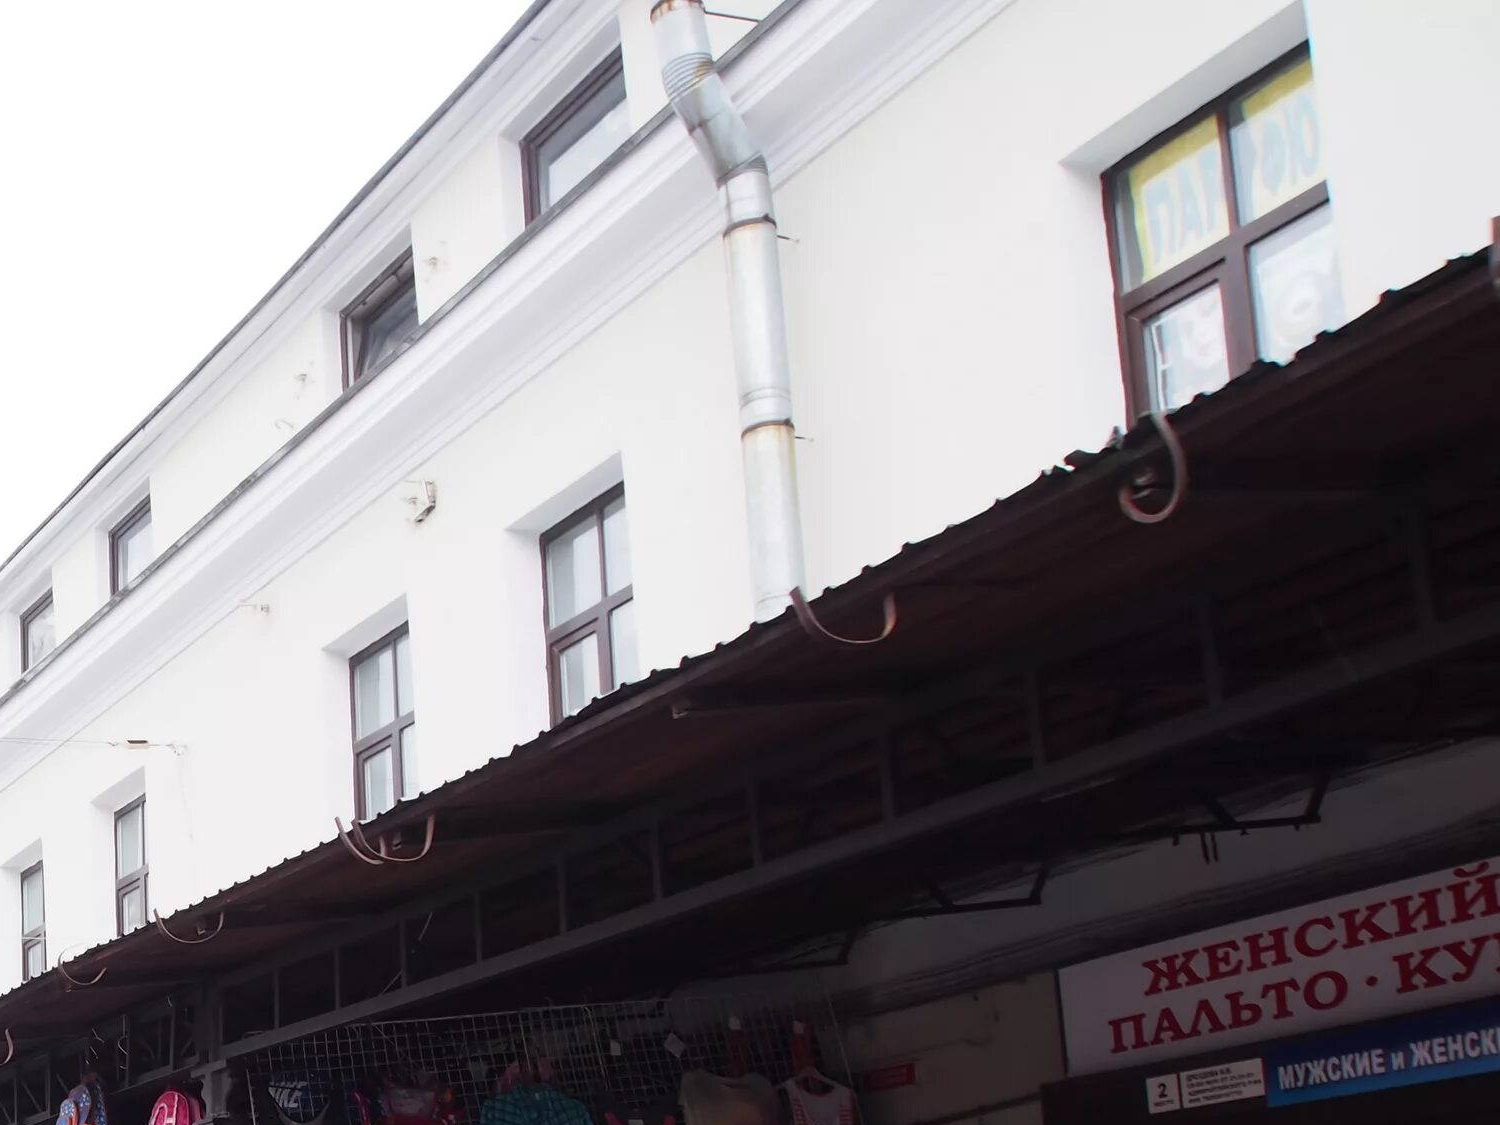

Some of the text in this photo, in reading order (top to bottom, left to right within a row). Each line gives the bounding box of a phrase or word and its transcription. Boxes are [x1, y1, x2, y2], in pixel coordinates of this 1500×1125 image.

[1141, 862, 1500, 996] ЖЕНСКИЙ
[1108, 932, 1500, 1054] ПАЛЬТО КУ
[1157, 1083, 1168, 1098] 2
[1278, 1049, 1386, 1090] МУЖСКИЕ
[1409, 1026, 1500, 1068] ЖЕНСК
